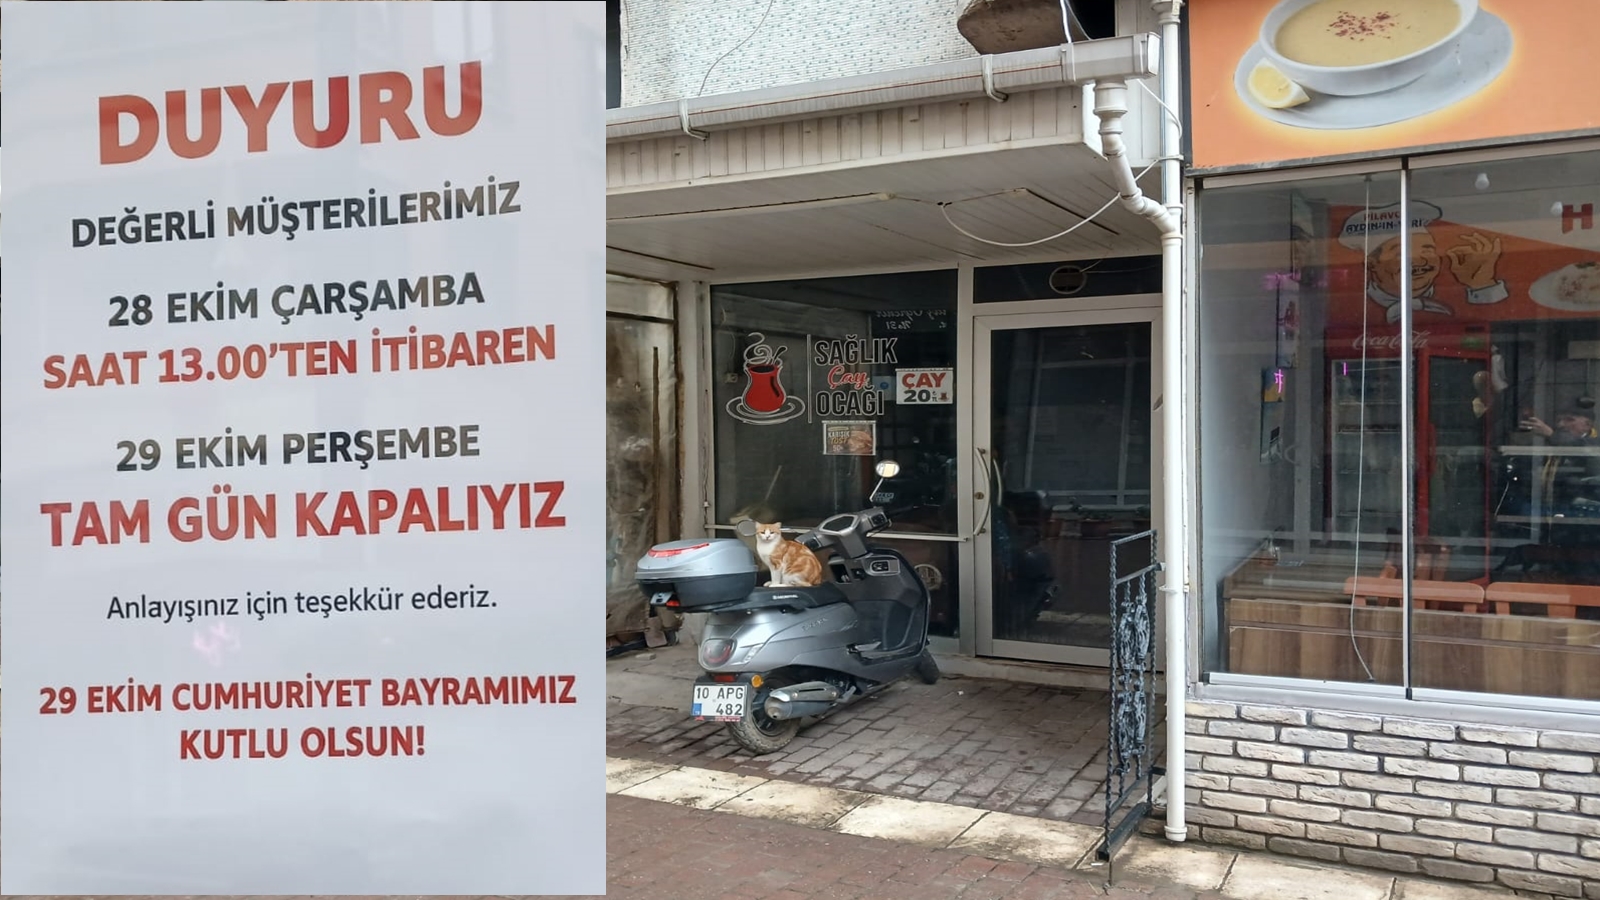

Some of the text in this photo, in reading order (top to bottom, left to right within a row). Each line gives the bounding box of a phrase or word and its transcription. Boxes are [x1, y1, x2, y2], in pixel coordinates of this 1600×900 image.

[98, 61, 484, 166] DUYURU
[72, 175, 521, 248] DEĞERLİ MÜŞTERİLERİMİZ
[1364, 210, 1401, 221] PİLAVC
[108, 272, 485, 327] 28 EKİM ÇARŞAMBA
[43, 325, 556, 389] SAAT 13.00’TEN İTİBAREN
[814, 334, 898, 366] SAĞLIK
[827, 364, 868, 389] Çay
[902, 372, 947, 389] ÇAY
[816, 385, 885, 416] OCAĞI
[903, 389, 931, 402] 20
[116, 425, 480, 472] 29 EKİM PERŞEMBE
[41, 481, 566, 547] TAM GÜN KAPALIYIZ
[107, 585, 497, 623] Anlayışınız için teşekkür ederiz.
[39, 673, 577, 714] 29 EKİM CUMHURİYET BAYRAMIMIZ
[696, 687, 744, 699] 10 APG
[716, 703, 743, 716] 482
[180, 726, 425, 759] KUTLU OLSUN!
